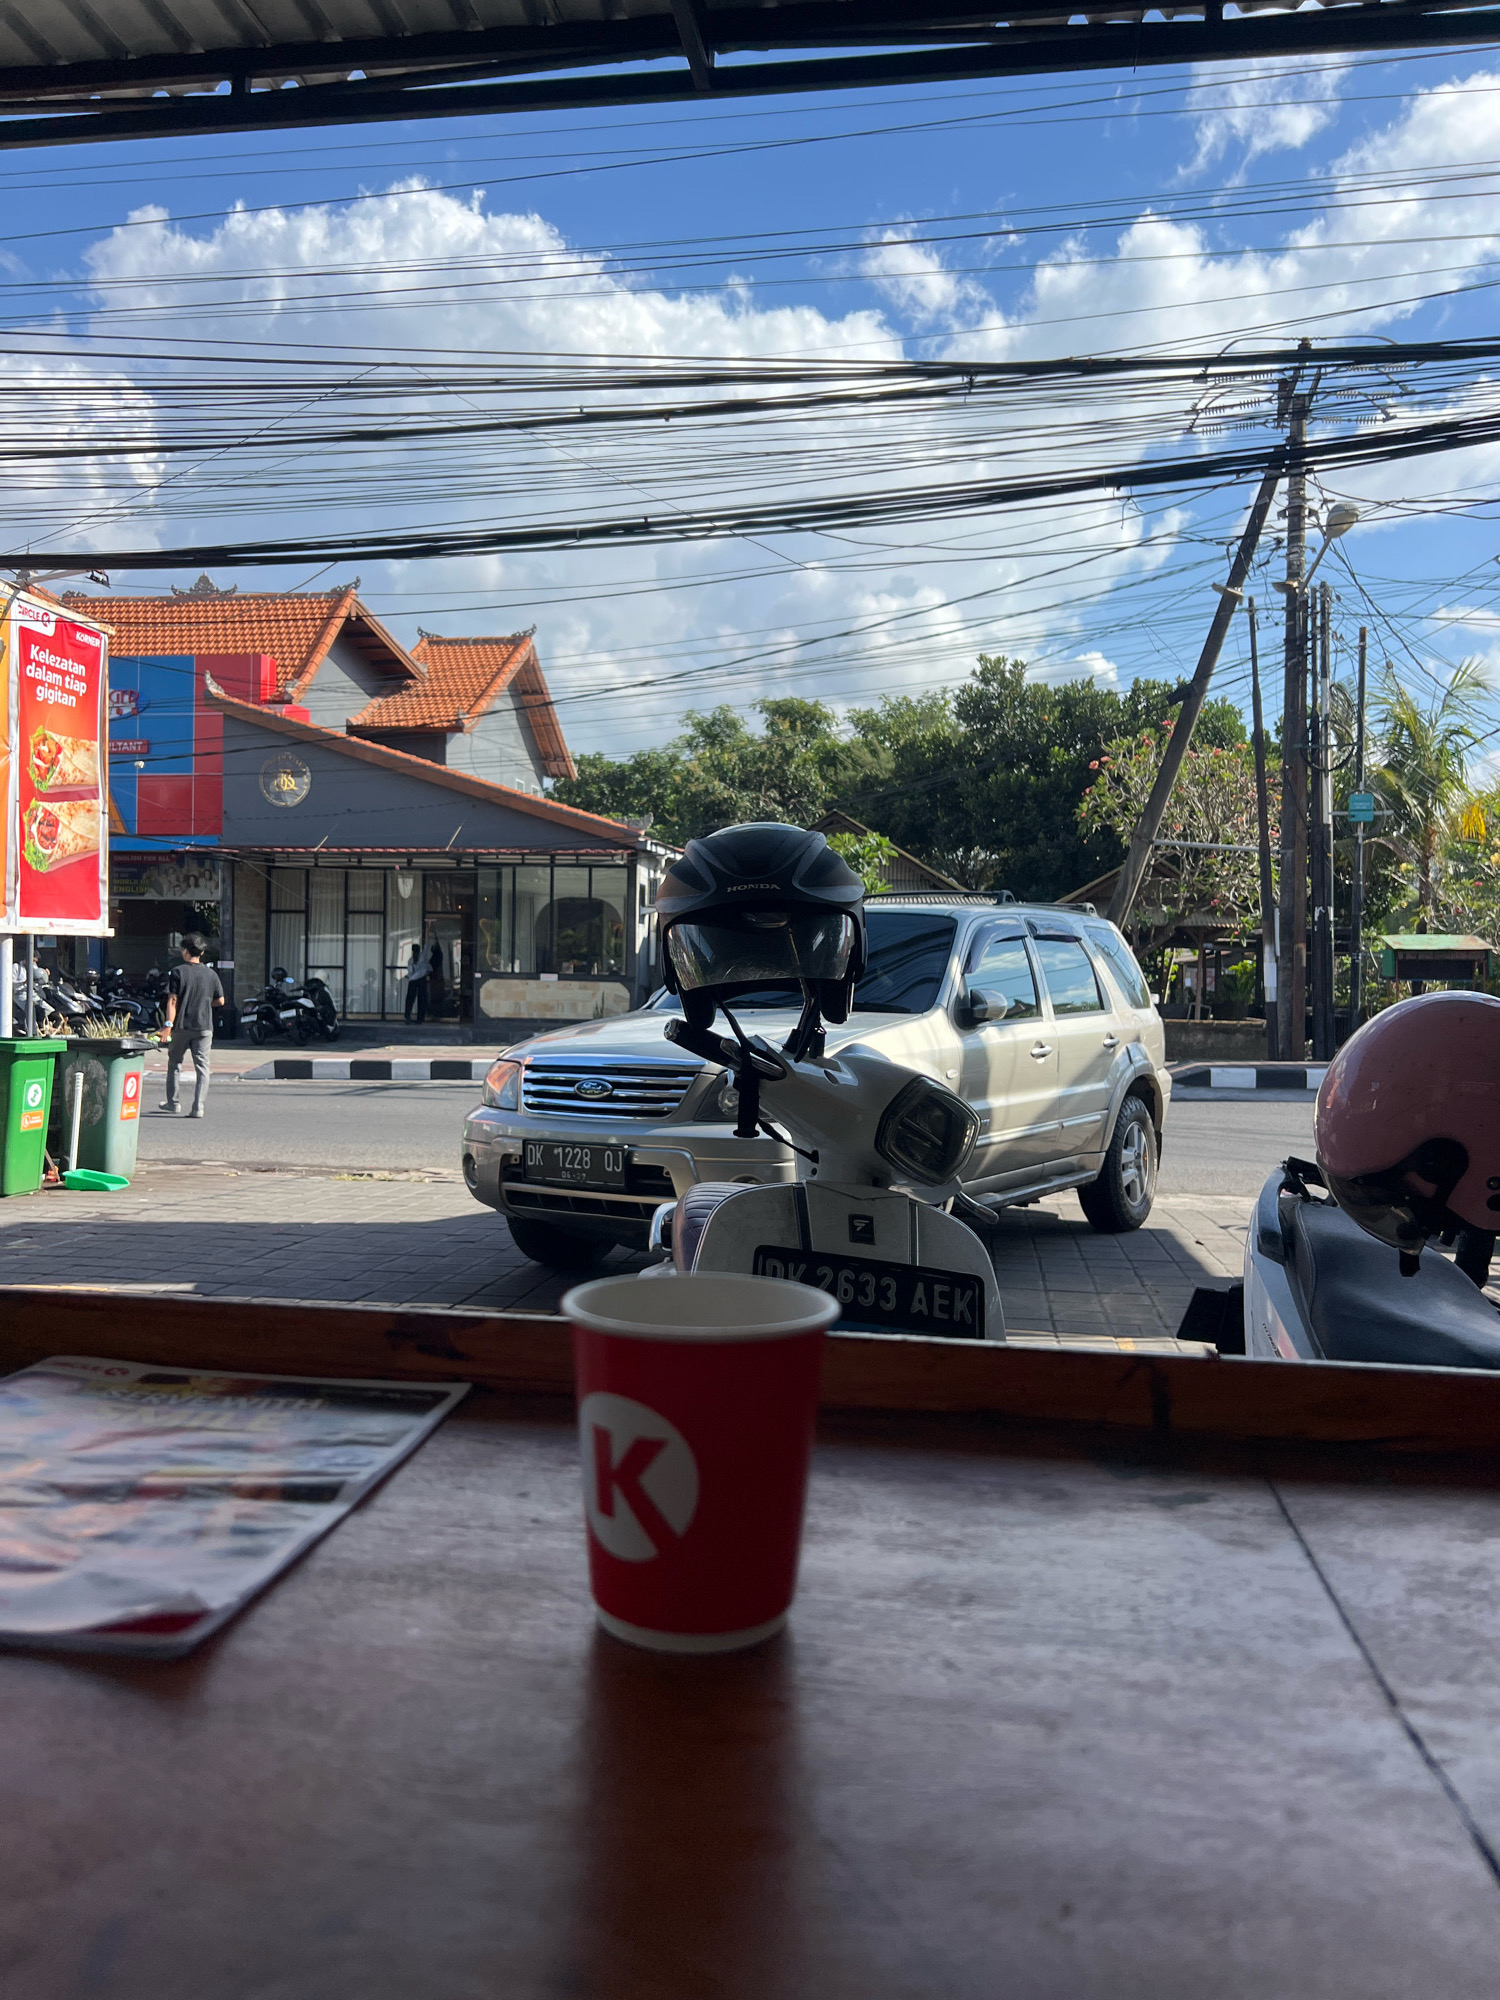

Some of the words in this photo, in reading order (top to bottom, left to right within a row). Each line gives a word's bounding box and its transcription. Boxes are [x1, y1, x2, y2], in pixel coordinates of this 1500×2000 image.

[29, 643, 86, 677] Kelezatan
[25, 661, 63, 686] dalam
[64, 673, 87, 697] tiap
[35, 682, 77, 708] gigitan
[726, 883, 781, 892] HONDA
[527, 1144, 544, 1166] DK
[555, 1147, 591, 1169] 1228
[816, 1266, 897, 1311] 2633
[910, 1281, 973, 1324] AEK
[592, 1423, 676, 1552] K
